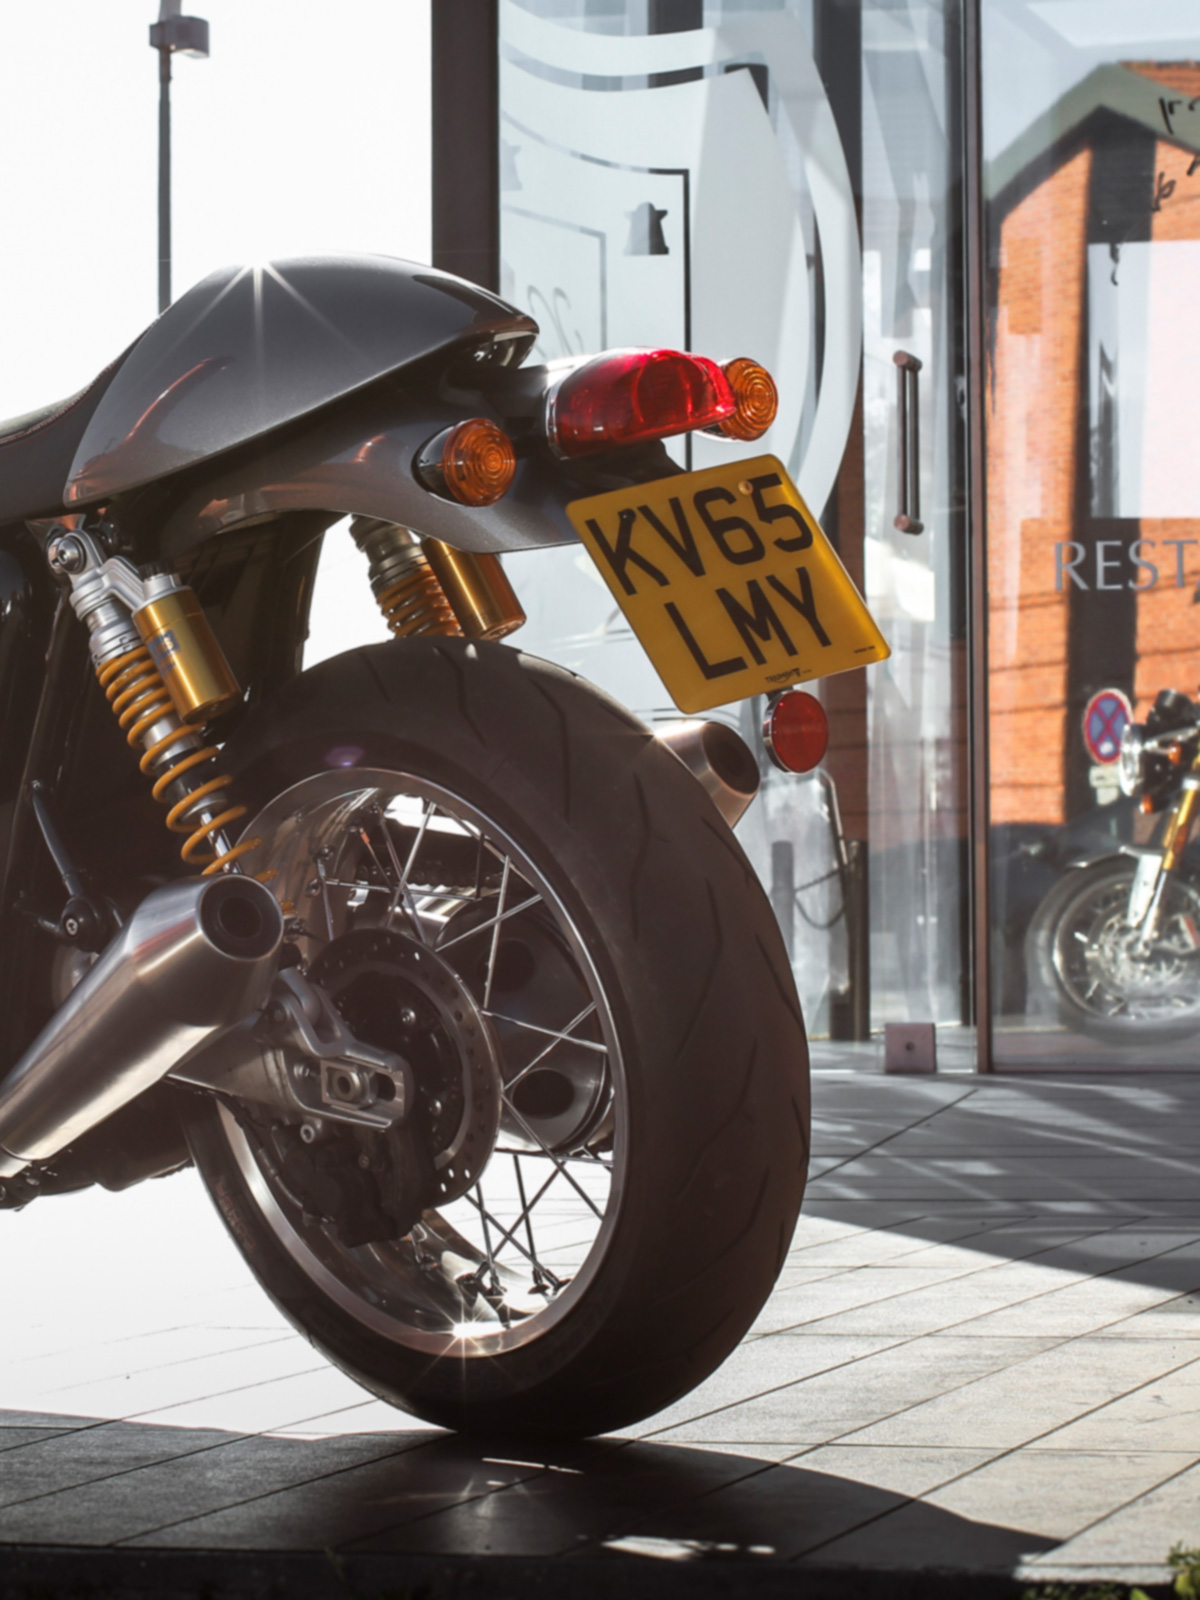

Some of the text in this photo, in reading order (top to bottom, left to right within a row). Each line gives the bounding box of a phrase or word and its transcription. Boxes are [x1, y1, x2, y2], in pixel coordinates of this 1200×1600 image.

[585, 472, 814, 596] KV65
[1054, 539, 1200, 592] REST
[663, 566, 832, 681] LMY
